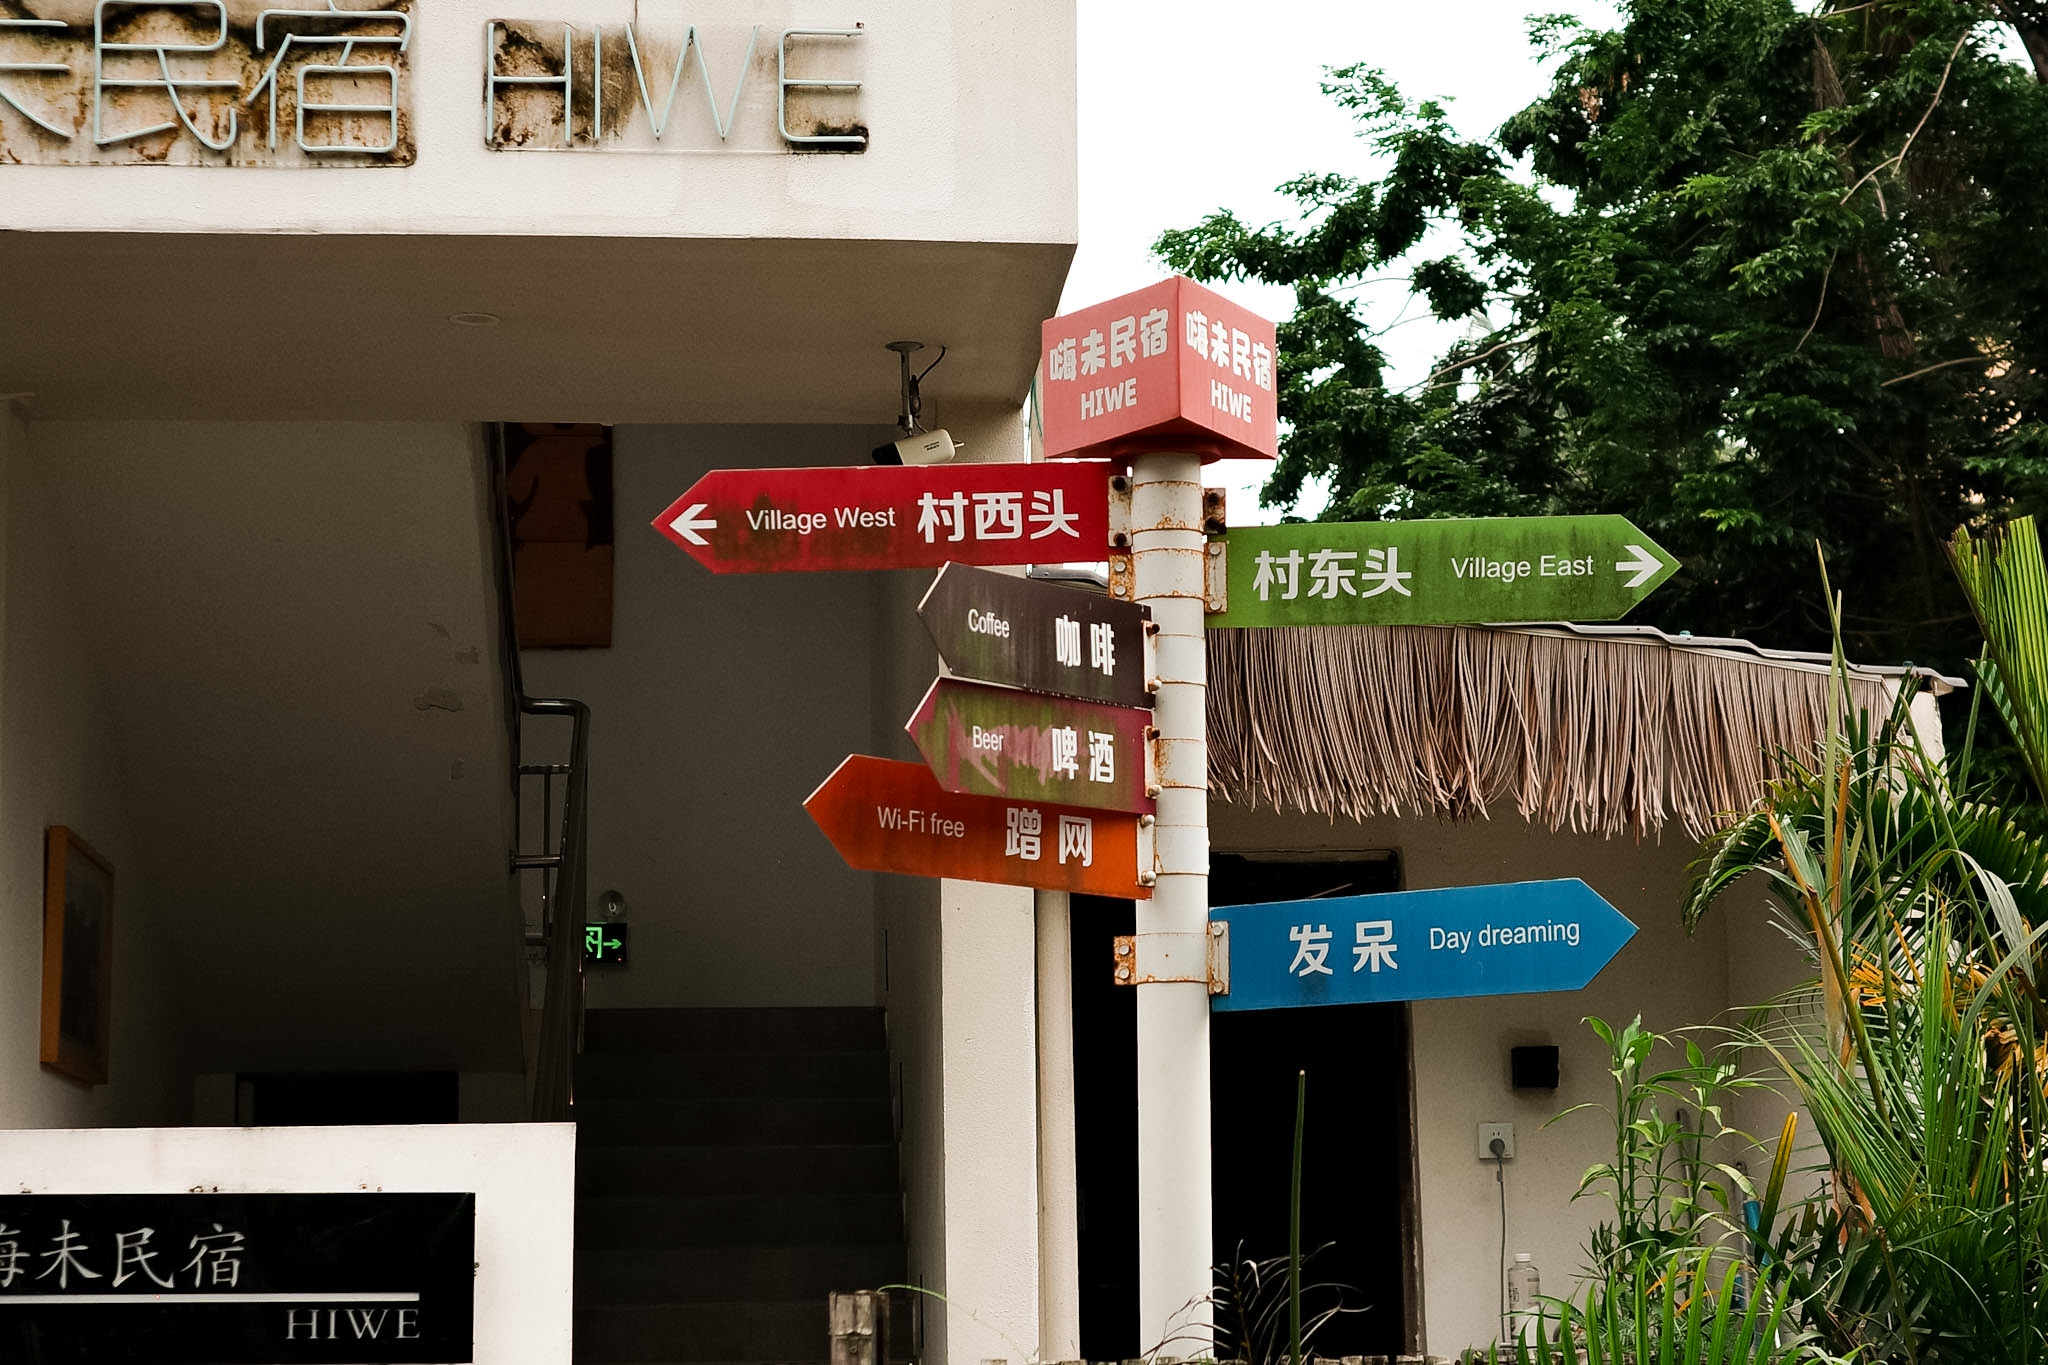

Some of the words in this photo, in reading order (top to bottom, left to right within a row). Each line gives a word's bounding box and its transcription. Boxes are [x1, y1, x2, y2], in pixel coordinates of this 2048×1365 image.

[485, 19, 866, 147] HIWE
[1049, 308, 1169, 381] 嗨未民宿
[1185, 310, 1272, 392] 嗨未民宿
[1080, 377, 1138, 421] HIWE
[1210, 379, 1252, 424] HIWE
[745, 509, 828, 535] Village
[834, 507, 897, 529] West
[917, 489, 1081, 544] 村西头
[1252, 546, 1412, 601] 村东头
[1450, 556, 1532, 583] Village
[1540, 555, 1594, 577] East
[968, 608, 1011, 640] Coffee
[1055, 614, 1116, 677] 咖啡
[972, 726, 1004, 752] Beer
[1051, 726, 1115, 784] 啤酒
[877, 806, 925, 834] Wi-Fi
[930, 812, 965, 839] free
[1005, 807, 1093, 868] 蹭网
[1289, 920, 1398, 977] 发呆
[1430, 925, 1472, 953] Day
[1478, 920, 1580, 948] dreaming
[286, 1308, 420, 1340] HIWE
